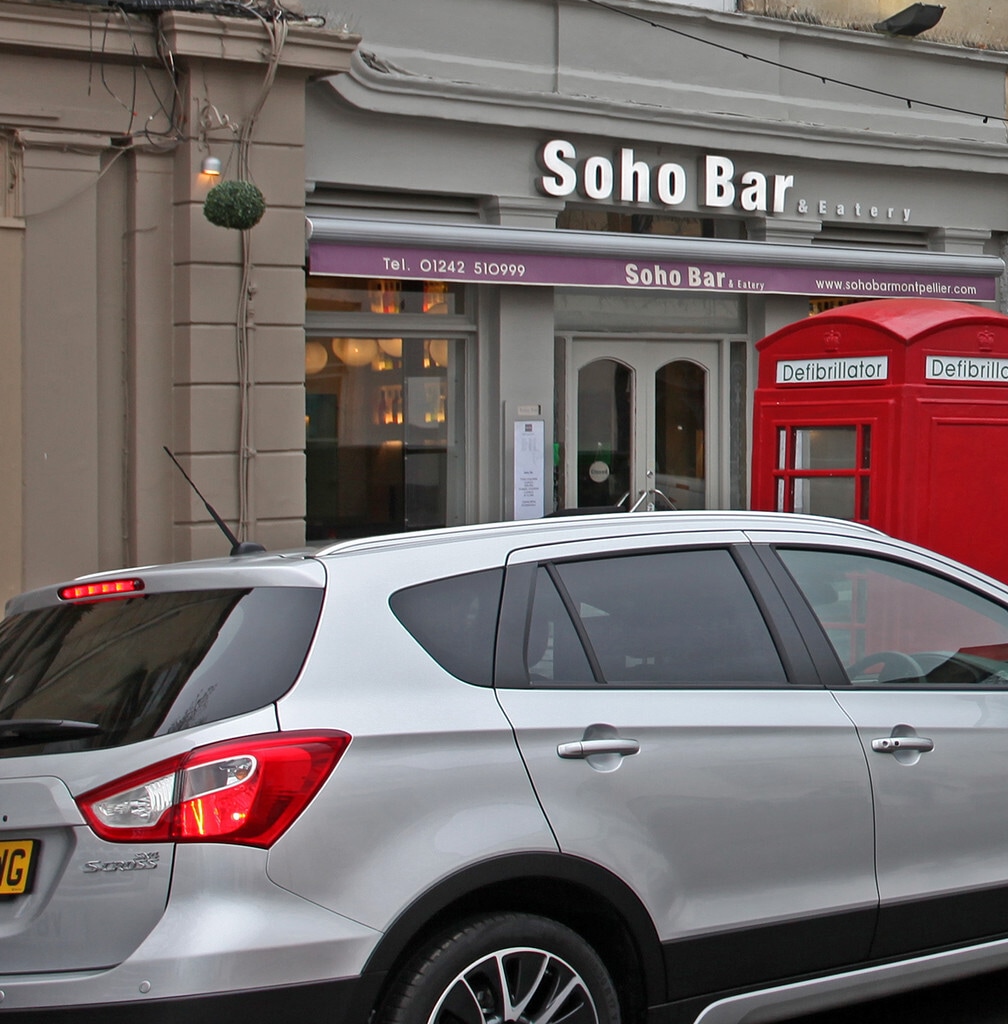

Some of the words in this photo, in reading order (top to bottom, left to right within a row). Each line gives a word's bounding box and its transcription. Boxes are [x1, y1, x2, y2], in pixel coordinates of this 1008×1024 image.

[542, 139, 686, 205] Soho
[704, 154, 794, 214] Bar
[798, 199, 808, 213] &
[818, 200, 911, 222] Eatery
[383, 257, 411, 272] Tel.
[420, 259, 465, 274] 01242
[473, 262, 526, 277] 510999
[625, 263, 681, 286] Soho
[688, 266, 726, 288] Bar
[728, 279, 734, 288] &
[737, 280, 765, 291] Eatery
[815, 279, 977, 295] www.sohobarmontpellier.com
[782, 362, 883, 382] Defibrillator
